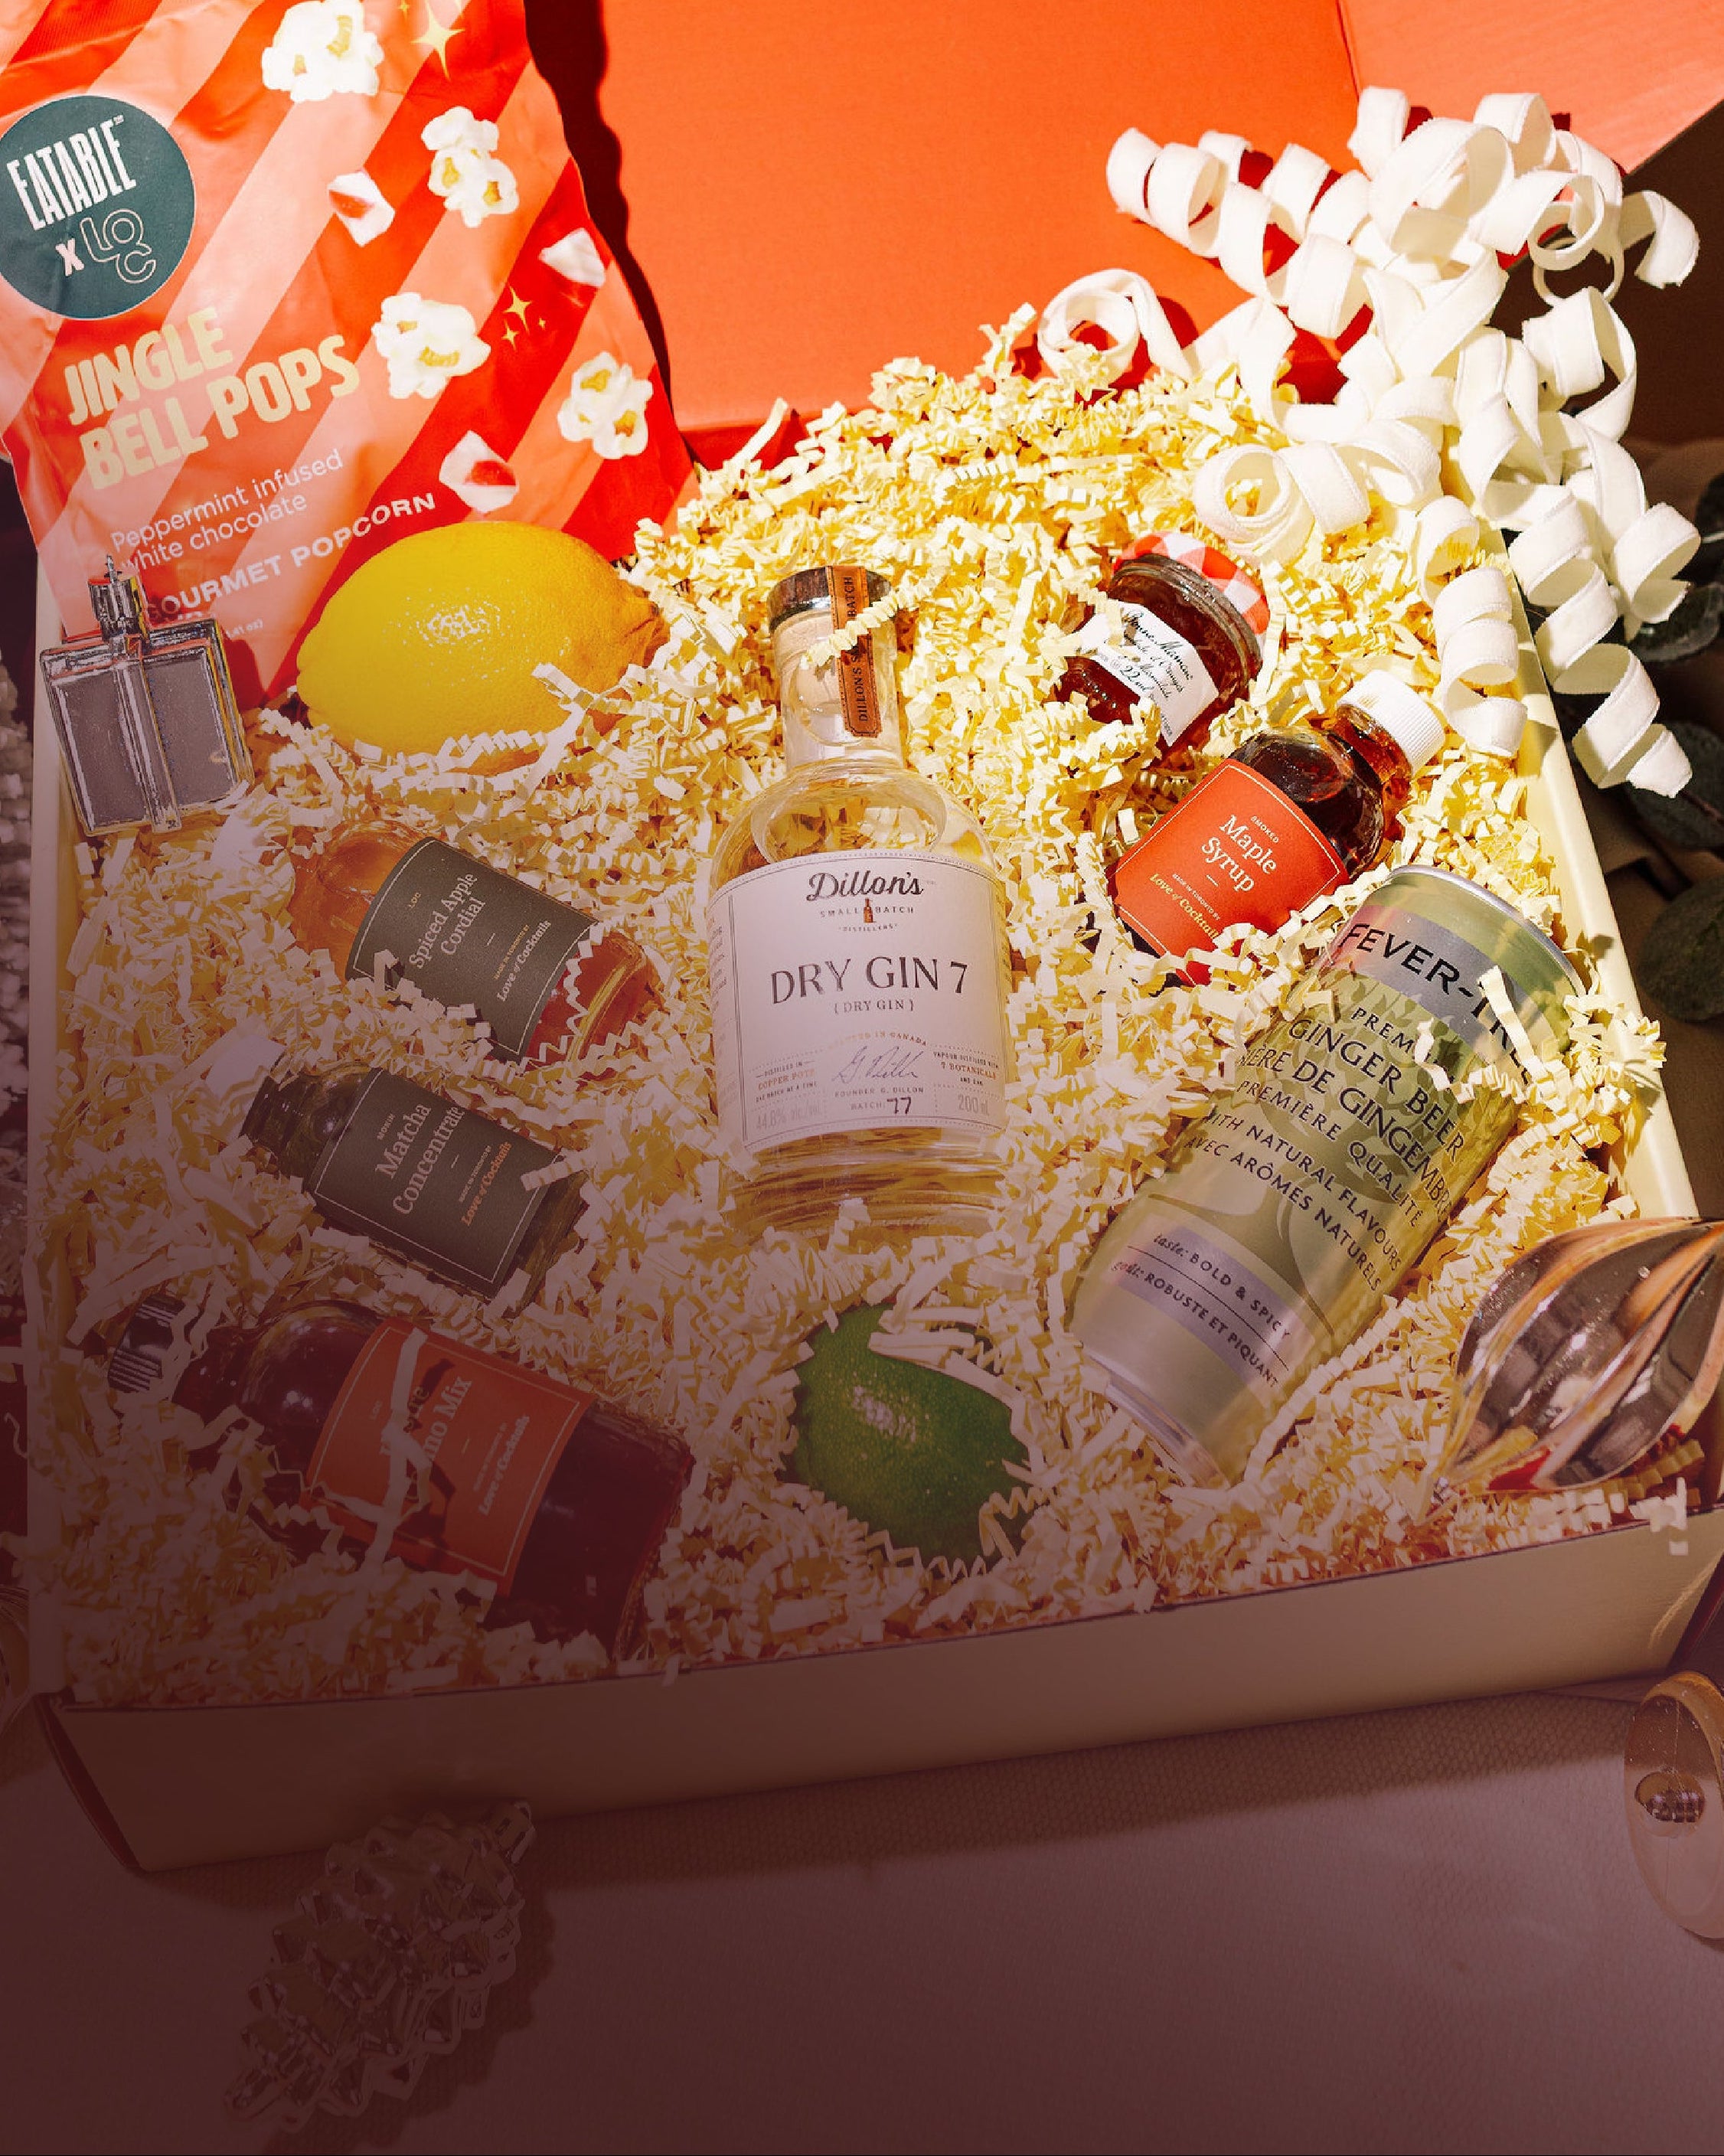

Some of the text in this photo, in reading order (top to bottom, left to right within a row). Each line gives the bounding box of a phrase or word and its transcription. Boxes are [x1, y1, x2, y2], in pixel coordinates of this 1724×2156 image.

[64, 307, 233, 426] JINGLE
[80, 335, 360, 490] BELL POPS
[110, 448, 344, 552] Peppermint infused
[189, 495, 307, 550] chocolate
[290, 492, 436, 568] POPCORN
[844, 577, 857, 618] BATCH
[1201, 837, 1255, 892] Syrup
[1220, 815, 1277, 874] Maple
[409, 873, 478, 969] Spiced Apple
[806, 871, 924, 901] Dillon's
[820, 906, 914, 918] SMALL BATCH
[1149, 874, 1174, 894] Love
[1180, 899, 1220, 939] Cocktail
[440, 900, 486, 956] Cordial
[497, 972, 517, 1002] Love
[517, 920, 551, 964] Cocktails
[770, 956, 968, 1004] DRY GIN 7
[886, 1096, 912, 1115] 77
[957, 1093, 978, 1113] 200
[1288, 1020, 1464, 1161] GINGER BEER
[1291, 1059, 1335, 1094] DE
[375, 1102, 432, 1179] Matcha
[393, 1105, 465, 1214] Concentrate
[1236, 1080, 1424, 1227] PREMIÈRE QUALITÉ
[461, 1194, 482, 1226] Love
[482, 1142, 512, 1186] Cocktails
[1184, 1137, 1381, 1291] AVEC ARÔMES NATURELS
[1246, 1125, 1334, 1191] NATURAL
[1338, 1187, 1401, 1271] FLAVOURS
[1153, 1233, 1291, 1340] taste: BOLD & SPICY
[1144, 1272, 1209, 1320] ROBUSTE
[1208, 1316, 1228, 1334] ET
[1228, 1332, 1278, 1387] PIQUANT
[433, 1377, 473, 1419] Mix
